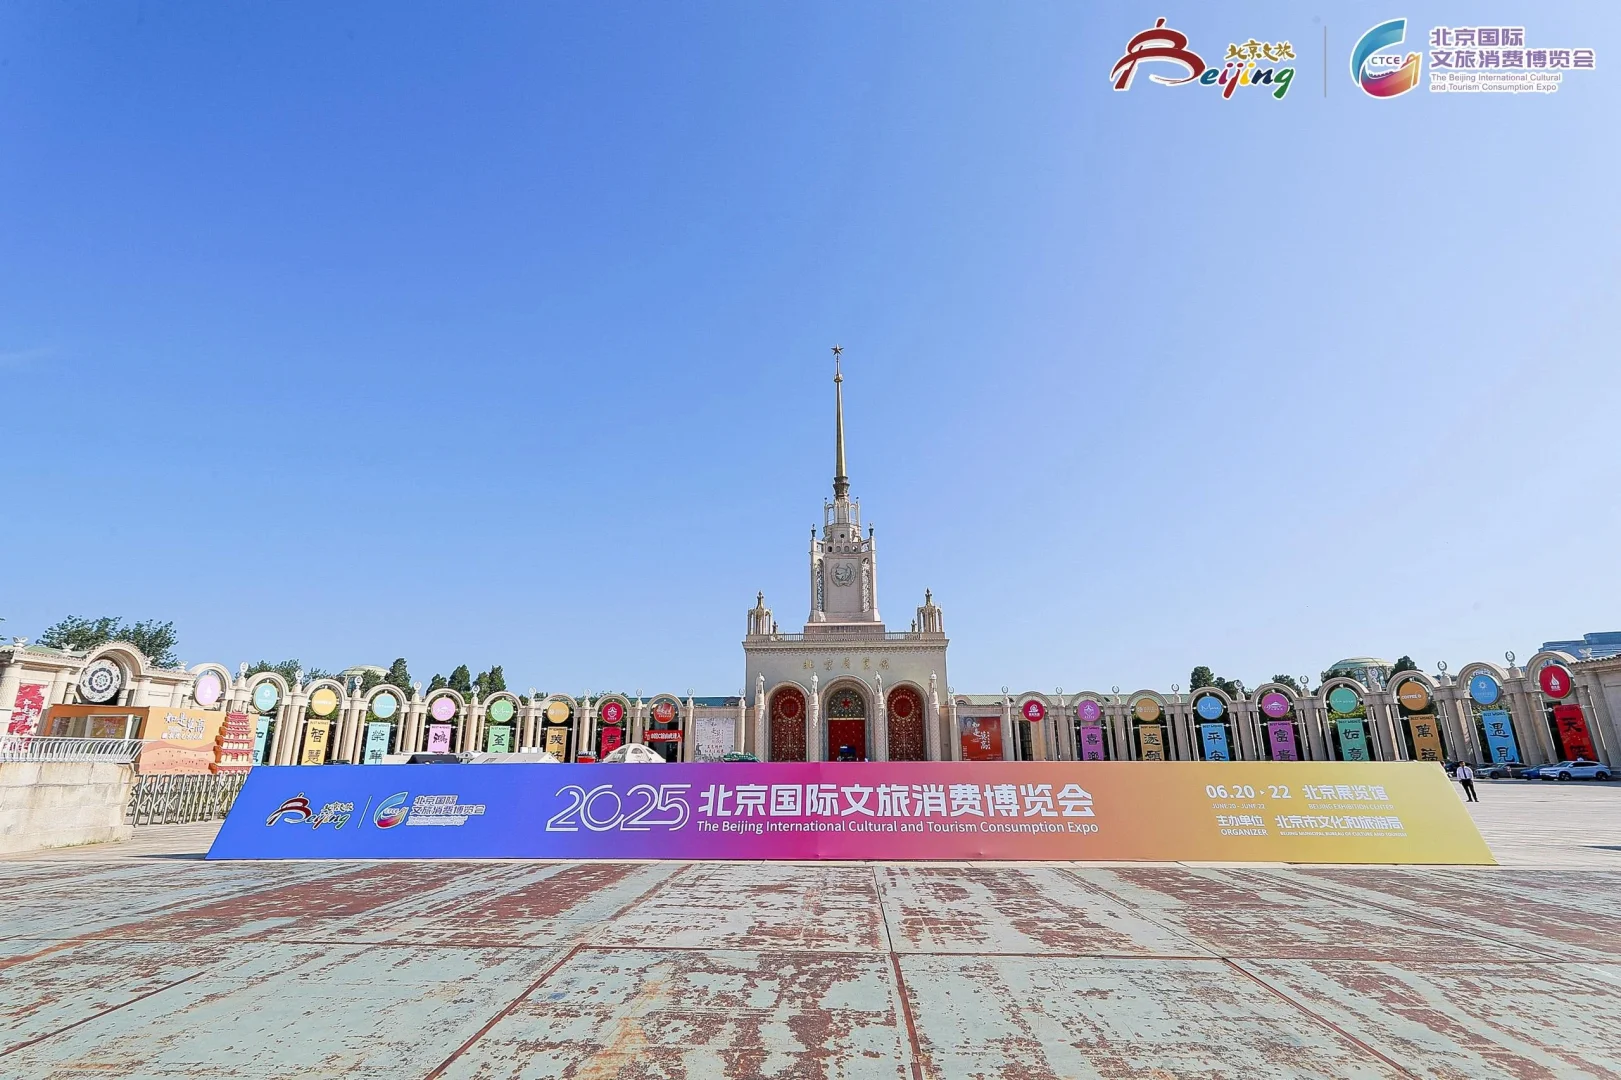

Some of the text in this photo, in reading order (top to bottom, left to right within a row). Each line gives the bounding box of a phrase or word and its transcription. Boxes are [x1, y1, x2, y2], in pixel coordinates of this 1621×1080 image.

[1205, 785, 1292, 799] 06.20 22
[1302, 784, 1389, 801] 北京展览馆
[545, 783, 1096, 832] 2025 北京国际文旅消费博览会
[697, 820, 1099, 835] The Beijing International Cultural and Tourism Consumption Expo
[1216, 815, 1265, 827] 主办单位
[1275, 815, 1404, 830] 北京市文化和旅游局
[1220, 828, 1269, 836] ORGANIZER
